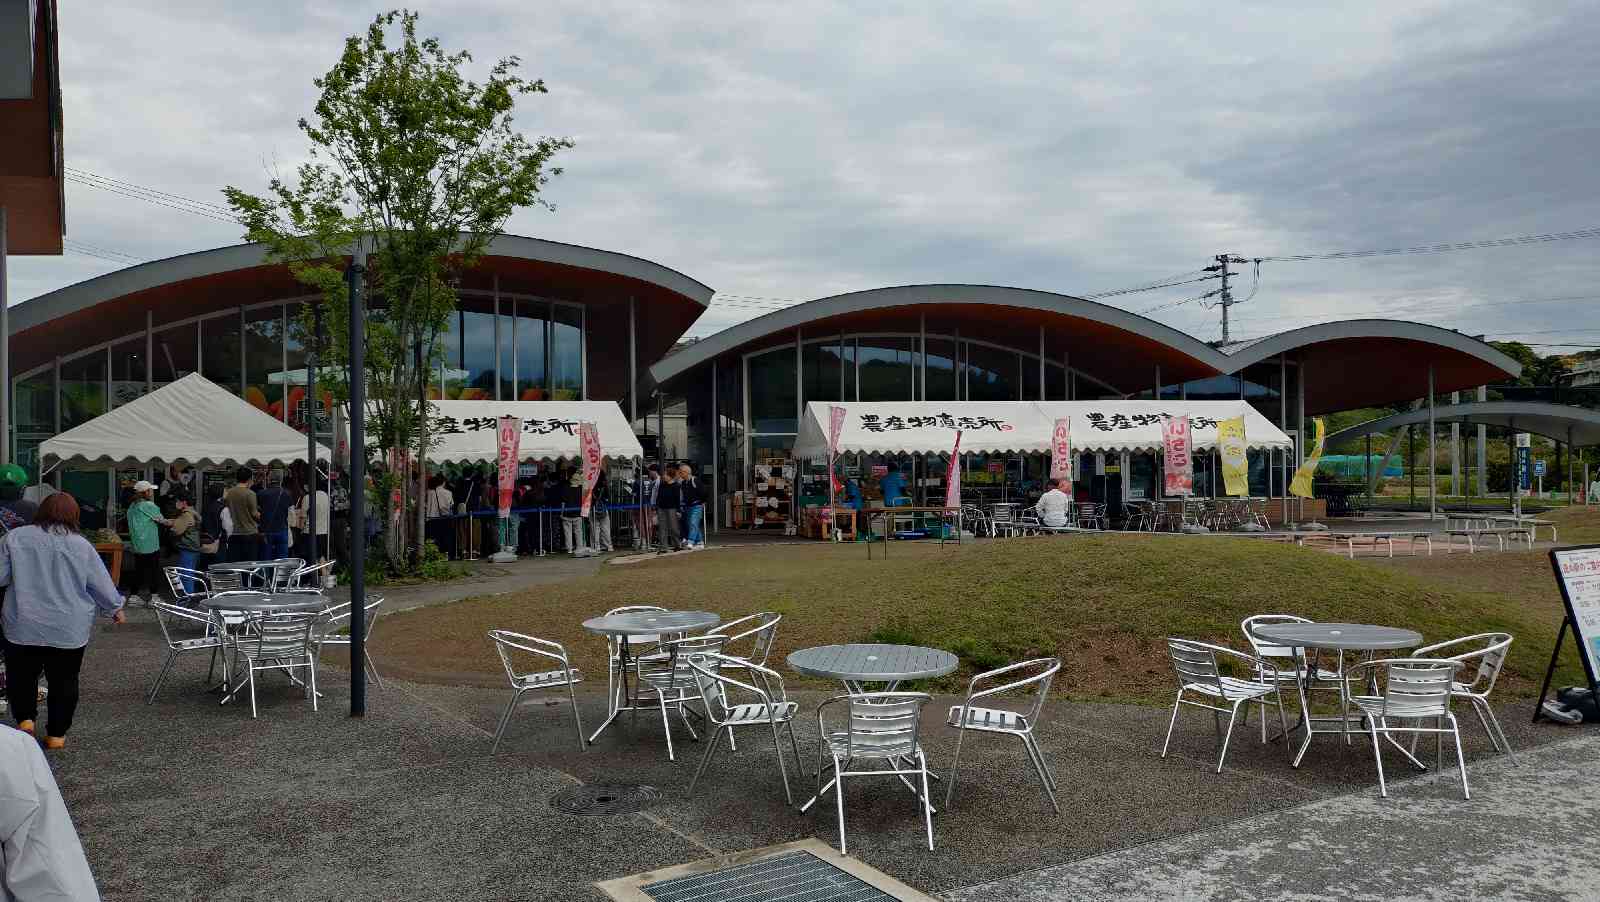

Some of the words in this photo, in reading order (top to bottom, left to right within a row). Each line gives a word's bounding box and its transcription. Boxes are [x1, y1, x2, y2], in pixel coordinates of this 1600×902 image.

[434, 414, 578, 436] 産物売所
[860, 412, 1006, 433] 農産物直売所
[1086, 412, 1218, 432] 農産物所
